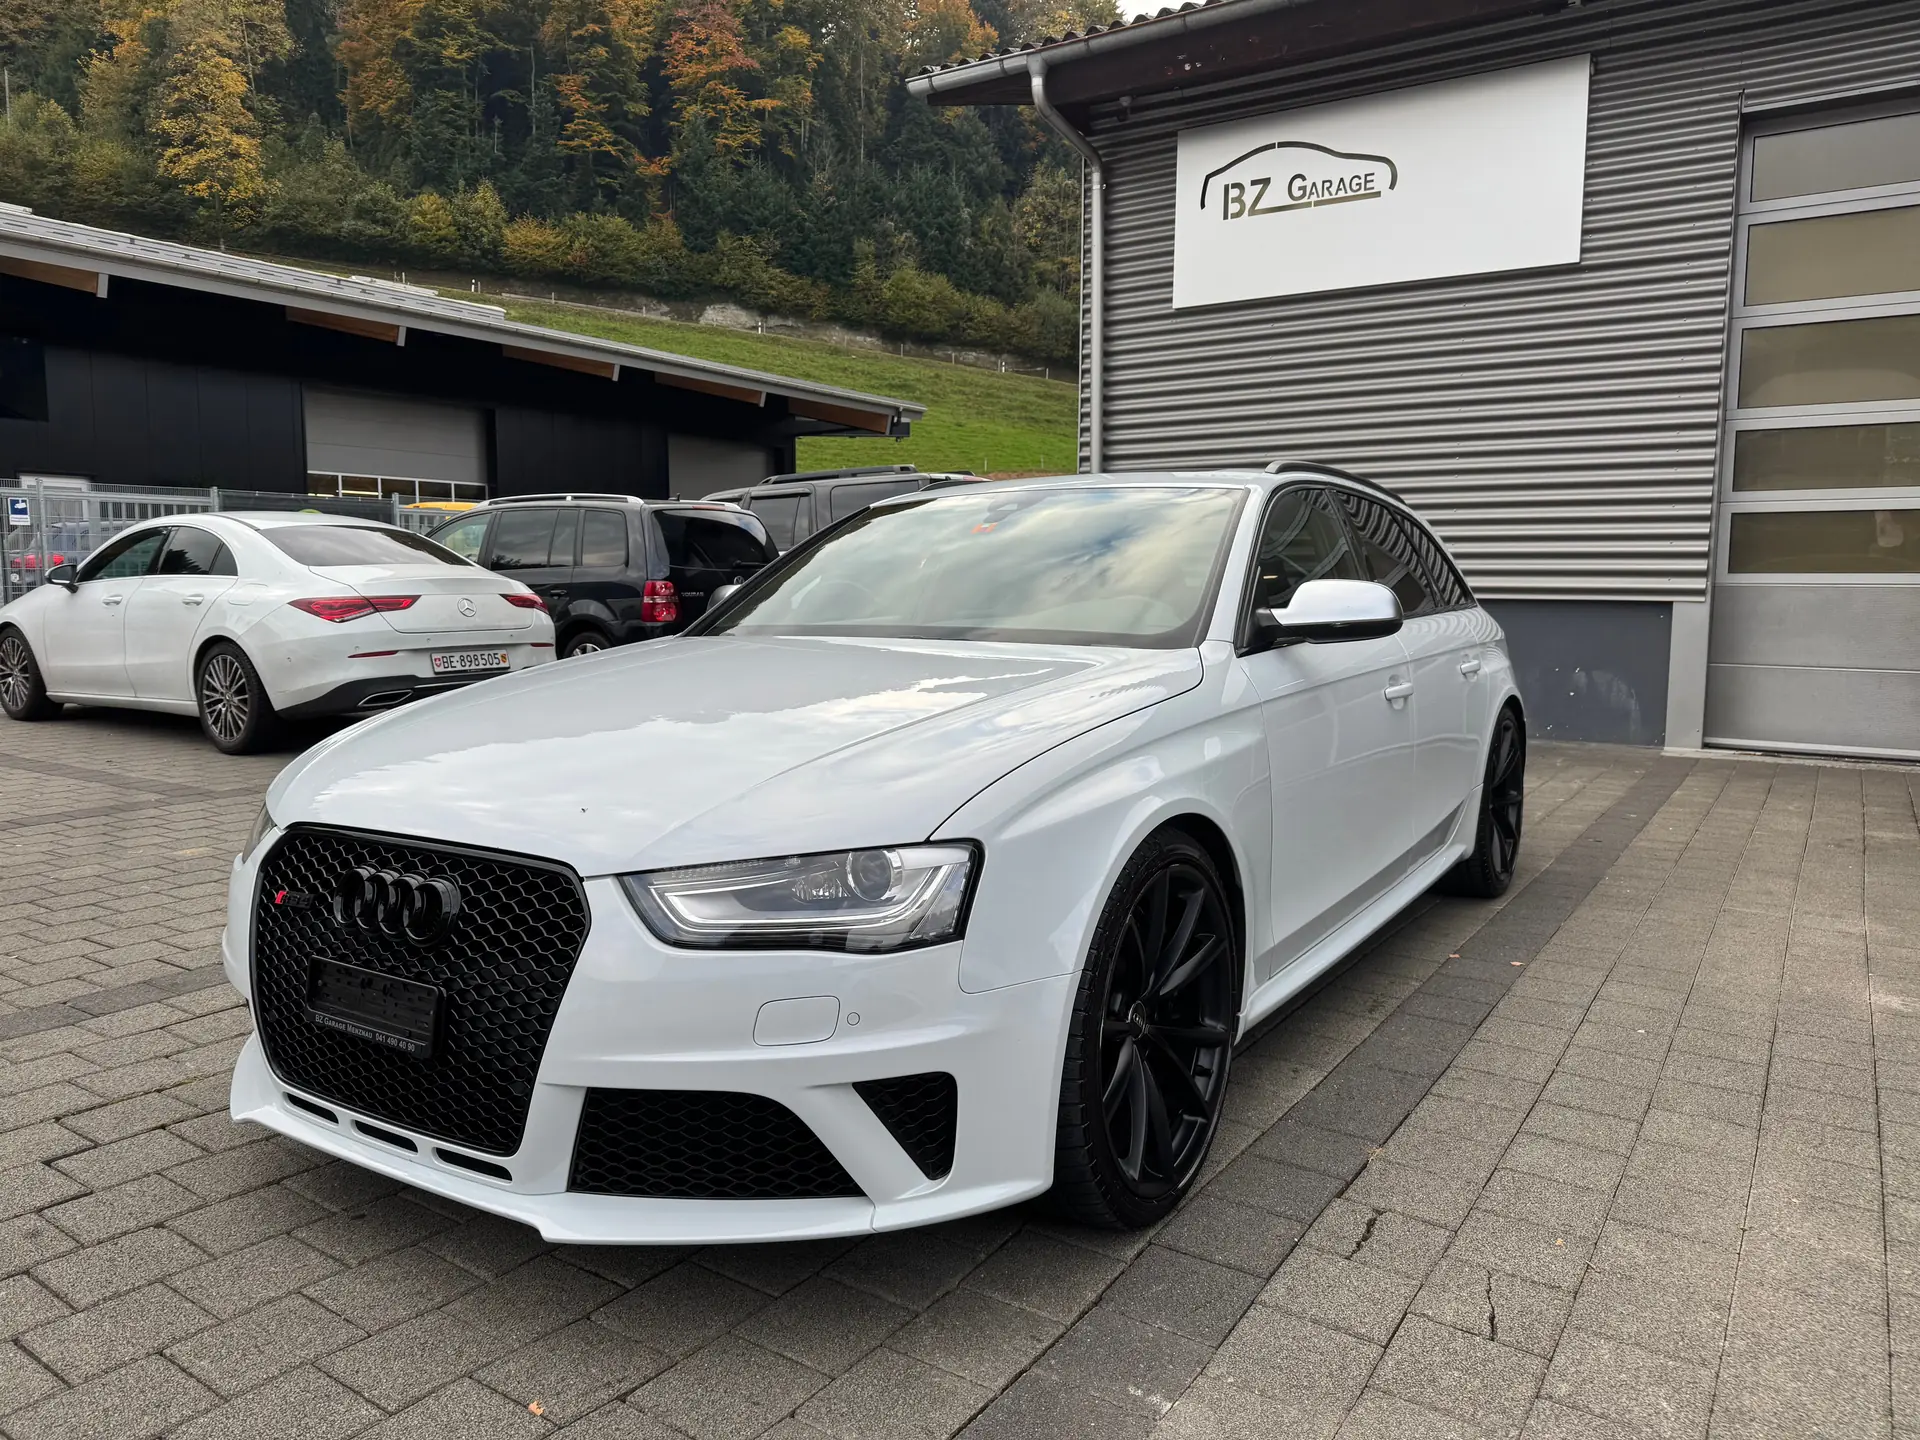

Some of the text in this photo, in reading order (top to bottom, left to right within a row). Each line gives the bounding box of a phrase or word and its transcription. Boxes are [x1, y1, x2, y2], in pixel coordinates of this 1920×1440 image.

[1223, 172, 1376, 220] BZ GARAGE
[315, 1014, 324, 1024] BZ
[324, 1017, 346, 1031] GARAGE
[375, 1032, 386, 1042] 041
[387, 1036, 398, 1047] 490
[399, 1040, 407, 1050] 40
[407, 1043, 416, 1052] 90
